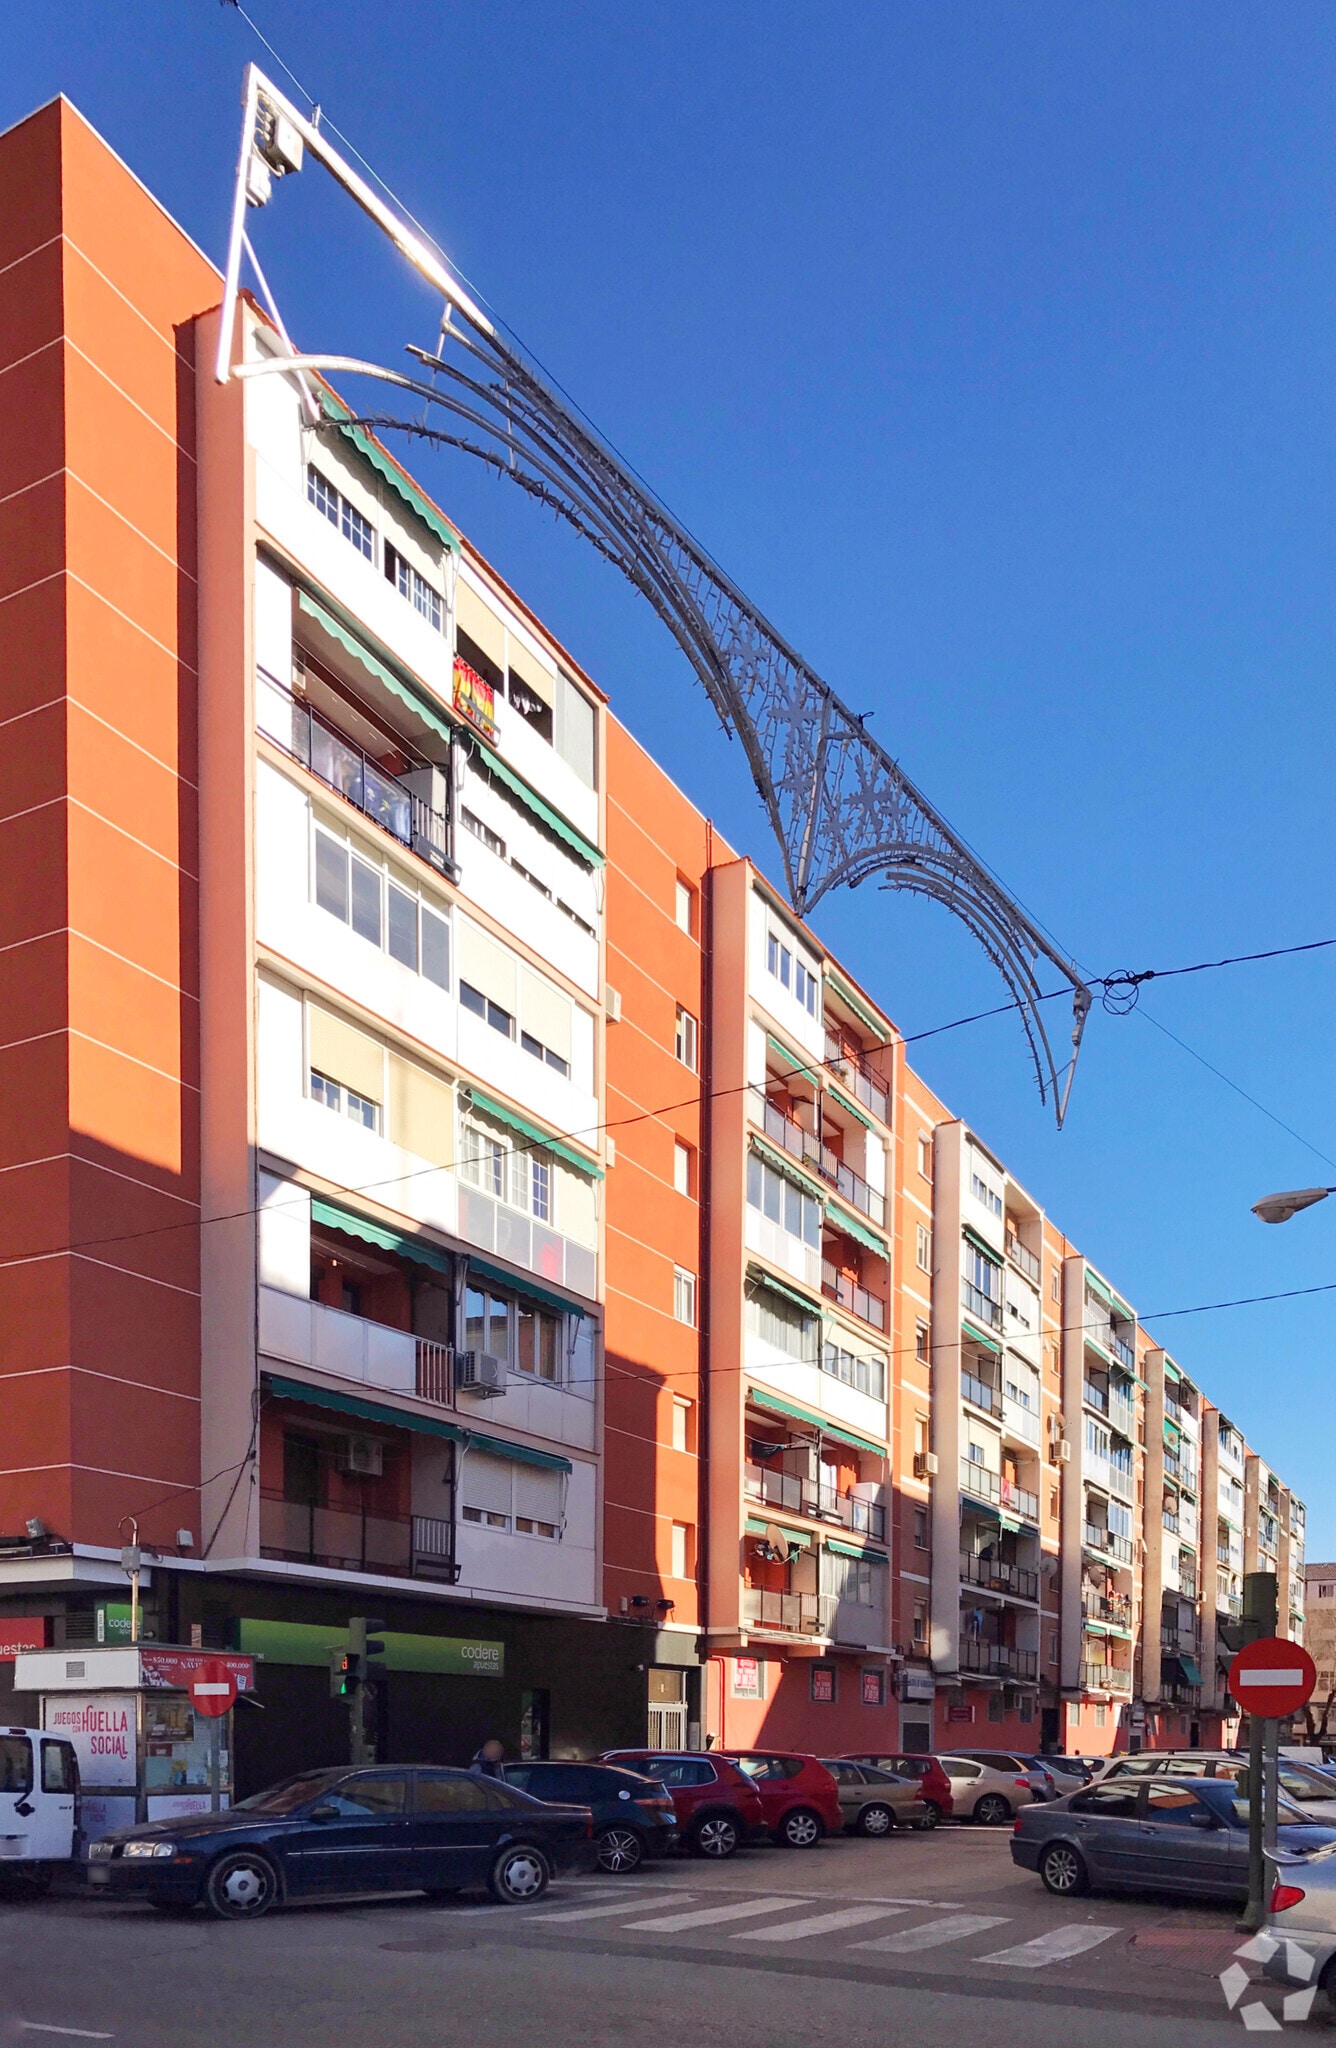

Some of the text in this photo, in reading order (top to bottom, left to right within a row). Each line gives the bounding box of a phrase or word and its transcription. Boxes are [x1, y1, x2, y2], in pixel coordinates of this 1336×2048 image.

[108, 1617, 141, 1629] codee
[461, 1643, 500, 1660] codere
[180, 1661, 202, 1669] NAVI
[473, 1661, 499, 1671] apuestas
[53, 1711, 81, 1725] JUEGOS
[82, 1704, 128, 1732] HUELLA
[72, 1725, 81, 1733] CON
[90, 1735, 128, 1760] SOCIAL
